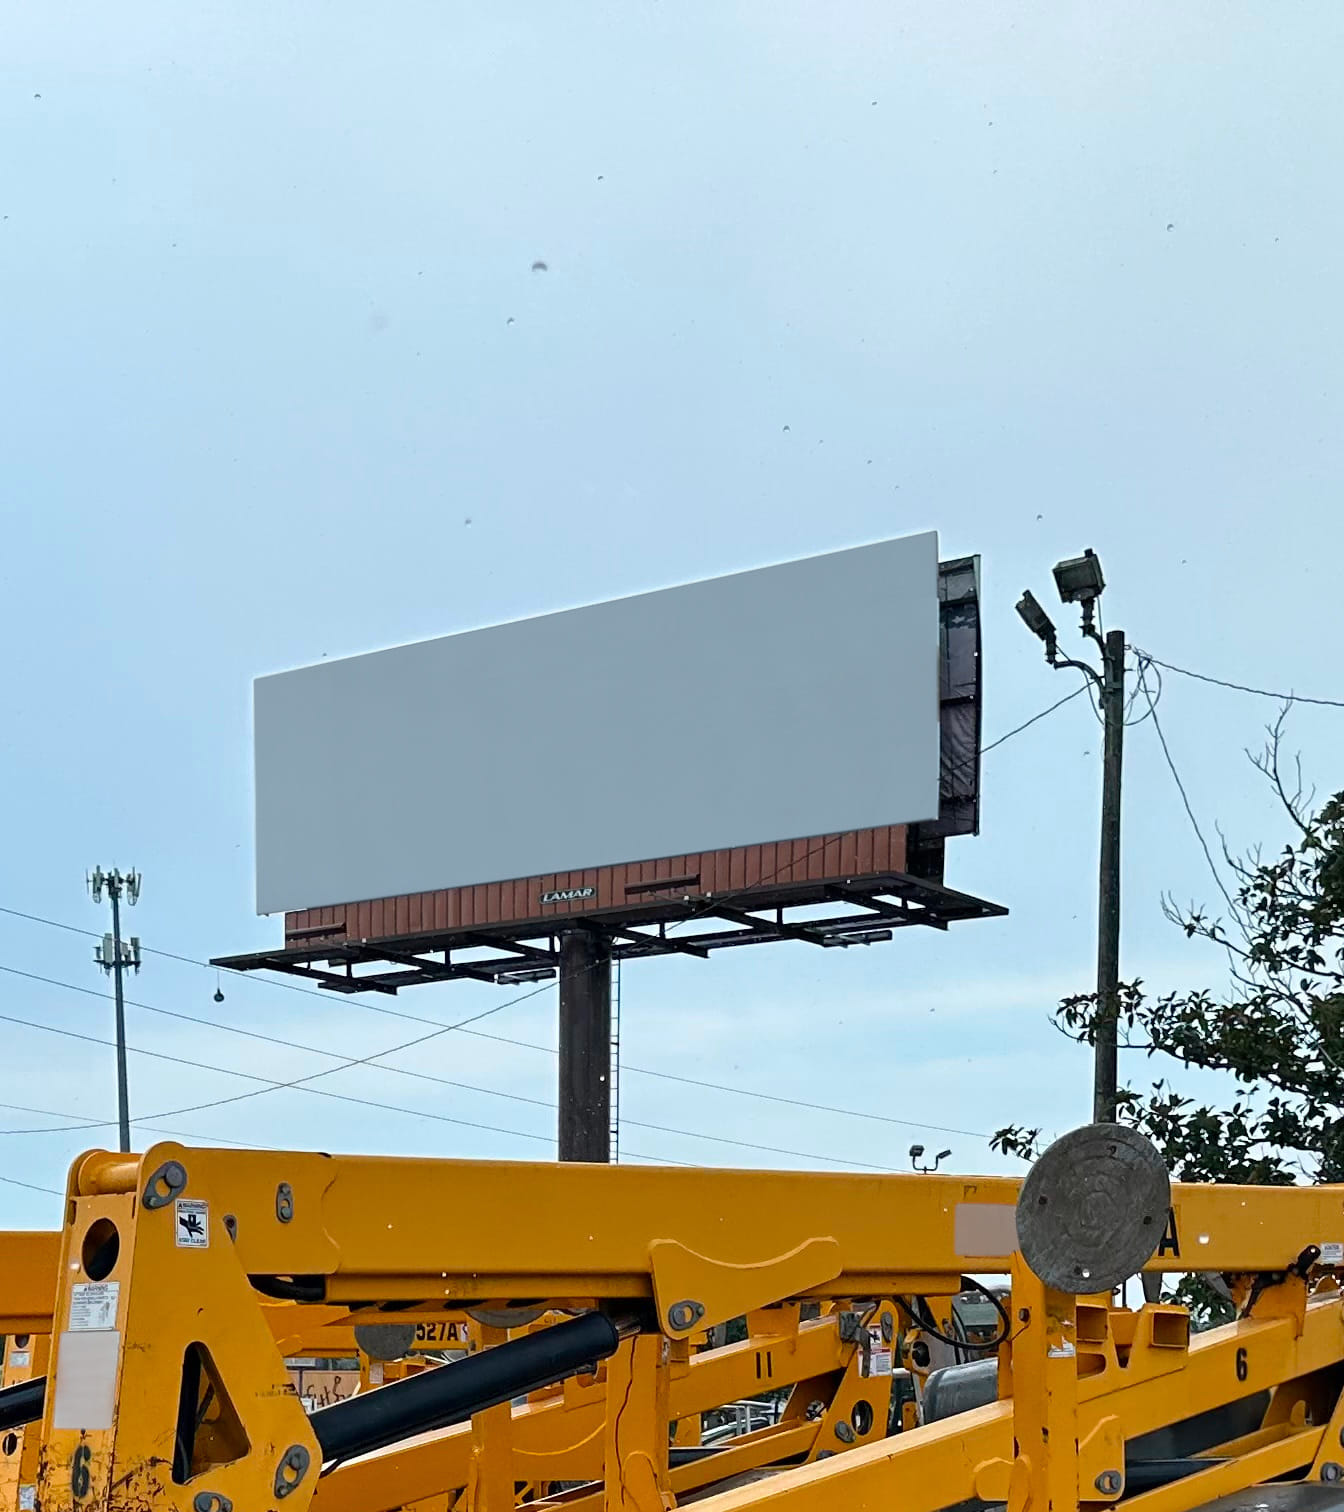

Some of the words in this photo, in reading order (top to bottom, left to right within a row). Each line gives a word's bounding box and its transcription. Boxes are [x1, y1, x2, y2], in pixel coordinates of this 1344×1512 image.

[543, 888, 592, 902] LAMAR
[1236, 1347, 1248, 1382] 6
[72, 1445, 91, 1498] 6
